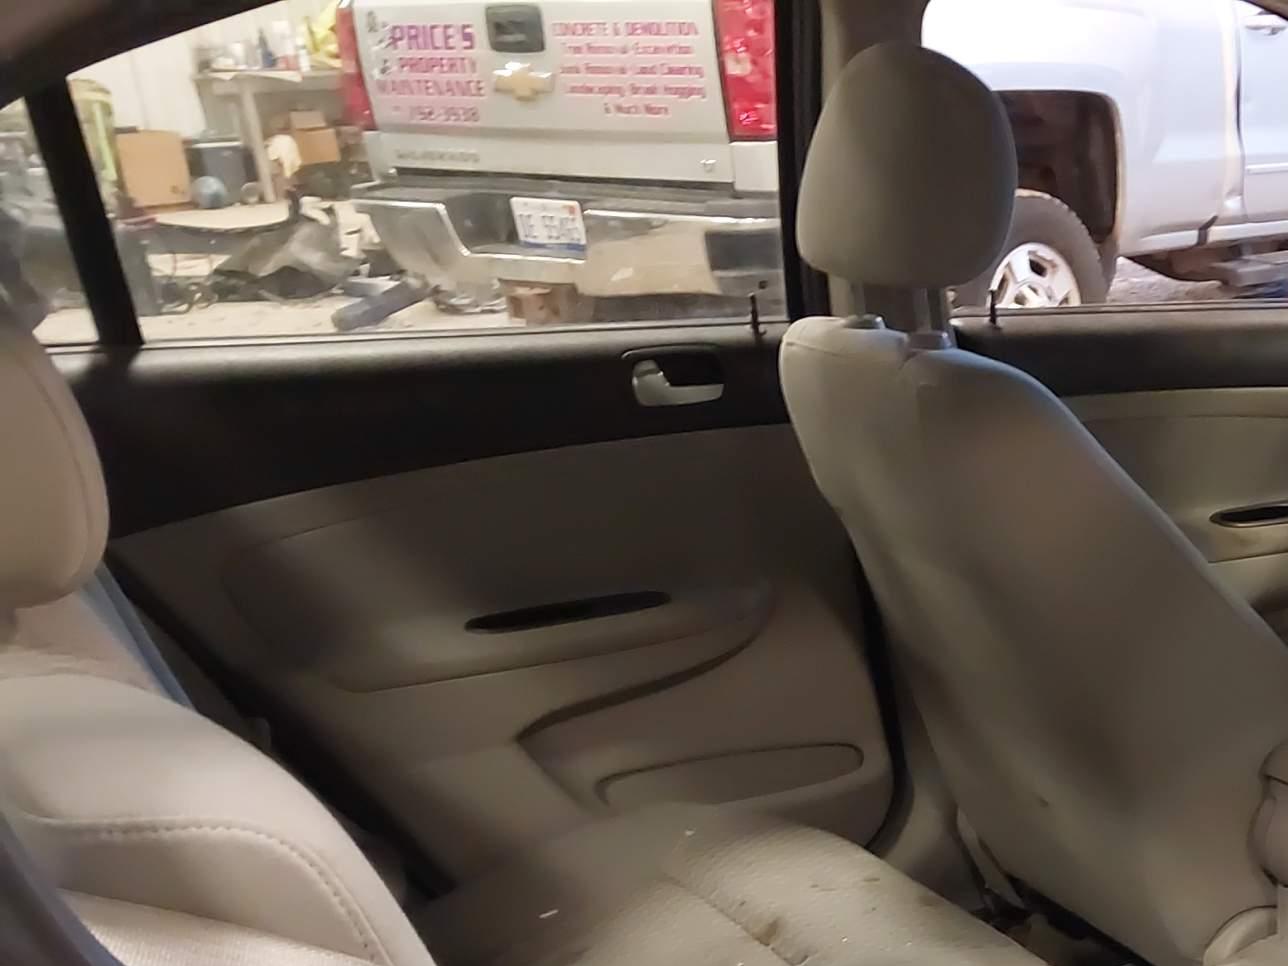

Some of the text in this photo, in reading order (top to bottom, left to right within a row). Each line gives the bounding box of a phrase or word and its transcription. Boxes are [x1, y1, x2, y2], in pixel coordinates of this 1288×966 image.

[552, 22, 609, 36] CONCRETE
[624, 22, 700, 36] DEMOLITION
[398, 56, 477, 74] PROPERTY
[376, 79, 487, 97] MAINTENANCE
